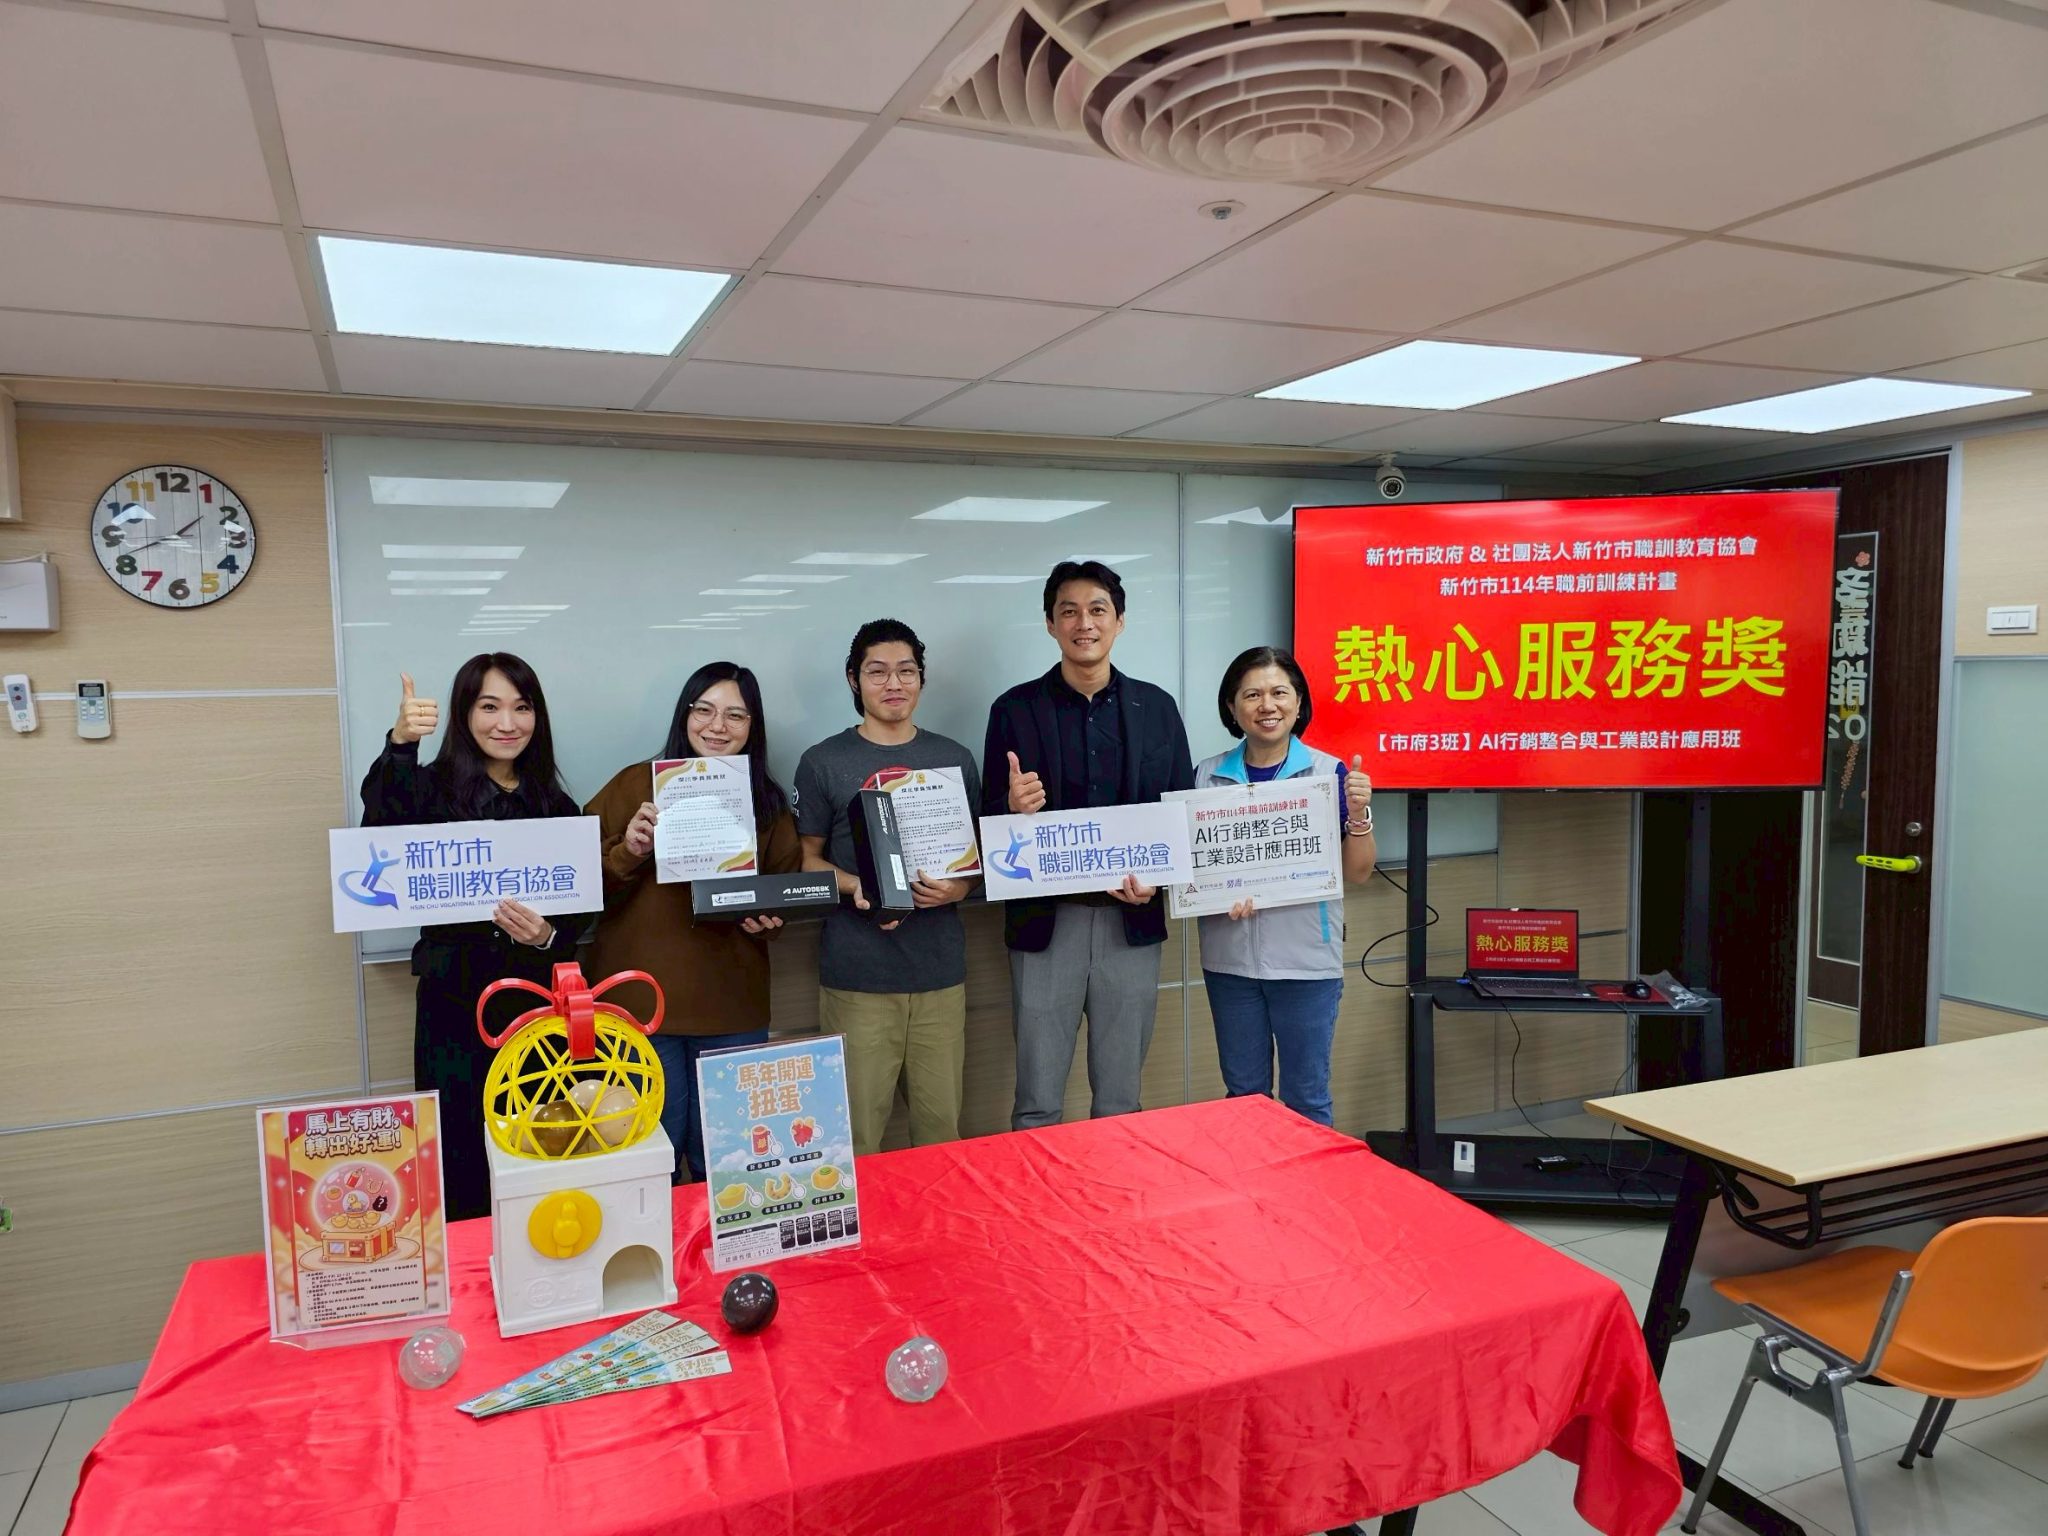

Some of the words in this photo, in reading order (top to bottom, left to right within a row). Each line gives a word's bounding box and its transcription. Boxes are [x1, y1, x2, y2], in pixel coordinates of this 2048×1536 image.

[126, 481, 155, 502] 11
[155, 472, 190, 493] 12
[199, 484, 212, 503] 1
[219, 506, 239, 525] 2
[101, 525, 124, 547] 9
[1365, 545, 1464, 567] 新竹市政府
[1469, 544, 1488, 563] &
[1492, 536, 1758, 564] 社團法人新竹市職訓教育協會
[116, 555, 137, 575] 8
[217, 555, 239, 574] 4
[141, 571, 163, 591] 7
[168, 578, 190, 600] 6
[200, 573, 220, 593] 5
[1439, 571, 1678, 597] 新竹市114年職前訓練計畫
[1333, 615, 1787, 703] 熱心服務獎
[1034, 821, 1102, 849] 新竹市
[1195, 813, 1309, 844] AI行銷整合與
[404, 837, 493, 869] 新竹市
[1038, 843, 1171, 875] 職訓教育協會
[1191, 835, 1322, 869] 工業設計應用班
[407, 864, 577, 901] 職訓教育協會
[792, 886, 829, 894] AUTODESK
[1476, 934, 1569, 953] 熱心服務獎
[737, 1055, 815, 1091] 馬年開運
[749, 1083, 803, 1119] 扭蛋
